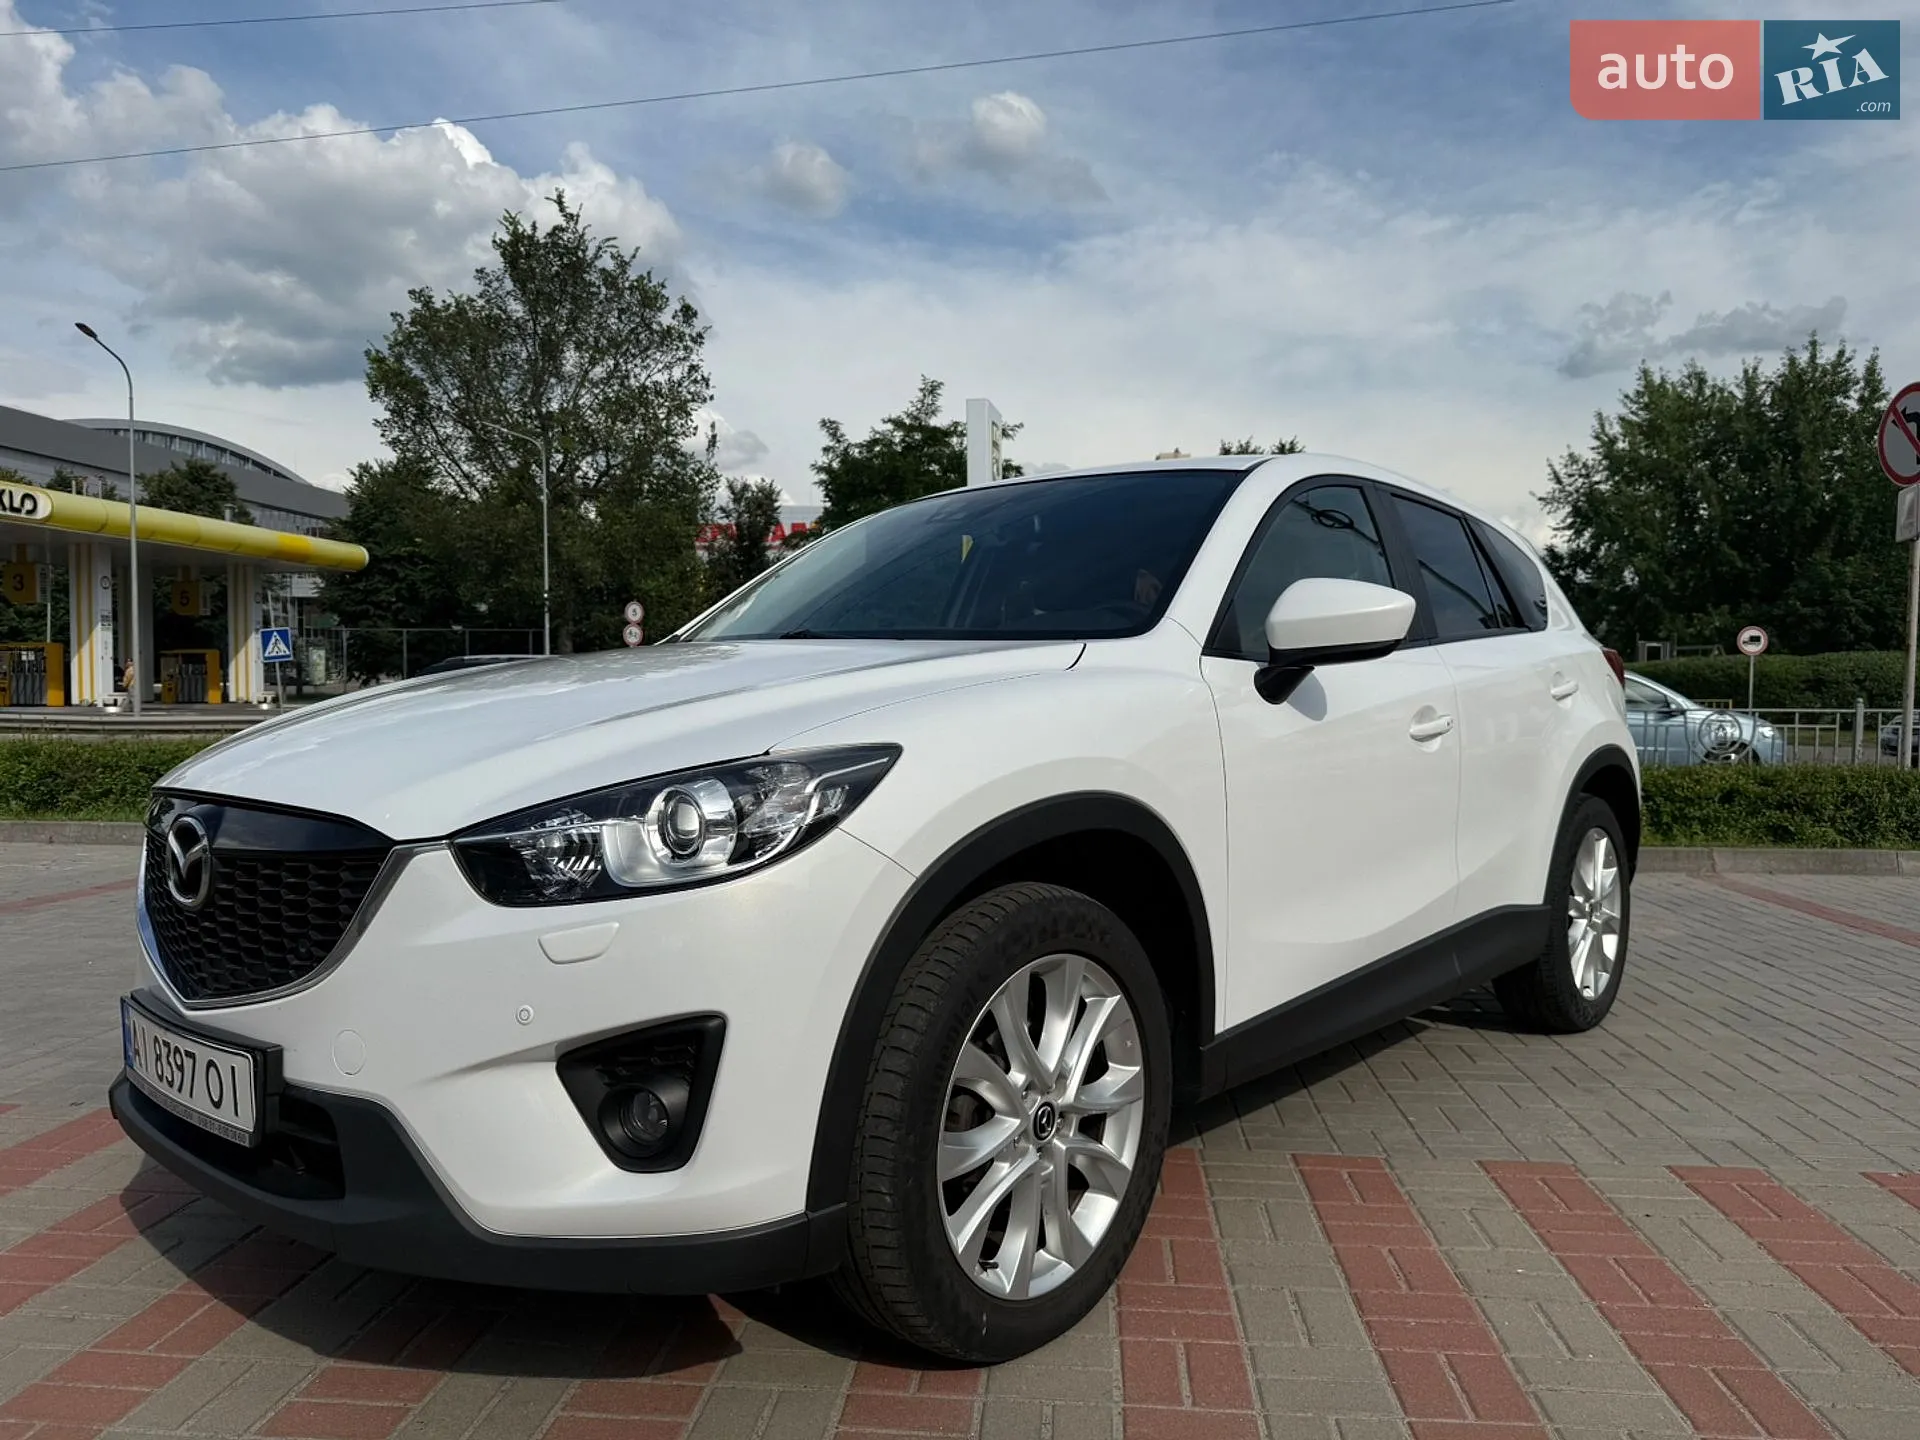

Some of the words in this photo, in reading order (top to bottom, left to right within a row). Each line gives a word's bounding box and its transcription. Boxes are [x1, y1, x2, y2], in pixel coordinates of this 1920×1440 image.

[12, 574, 25, 591] 3
[132, 1019, 149, 1073] AI
[153, 1035, 196, 1099] 8397
[205, 1058, 239, 1118] OI
